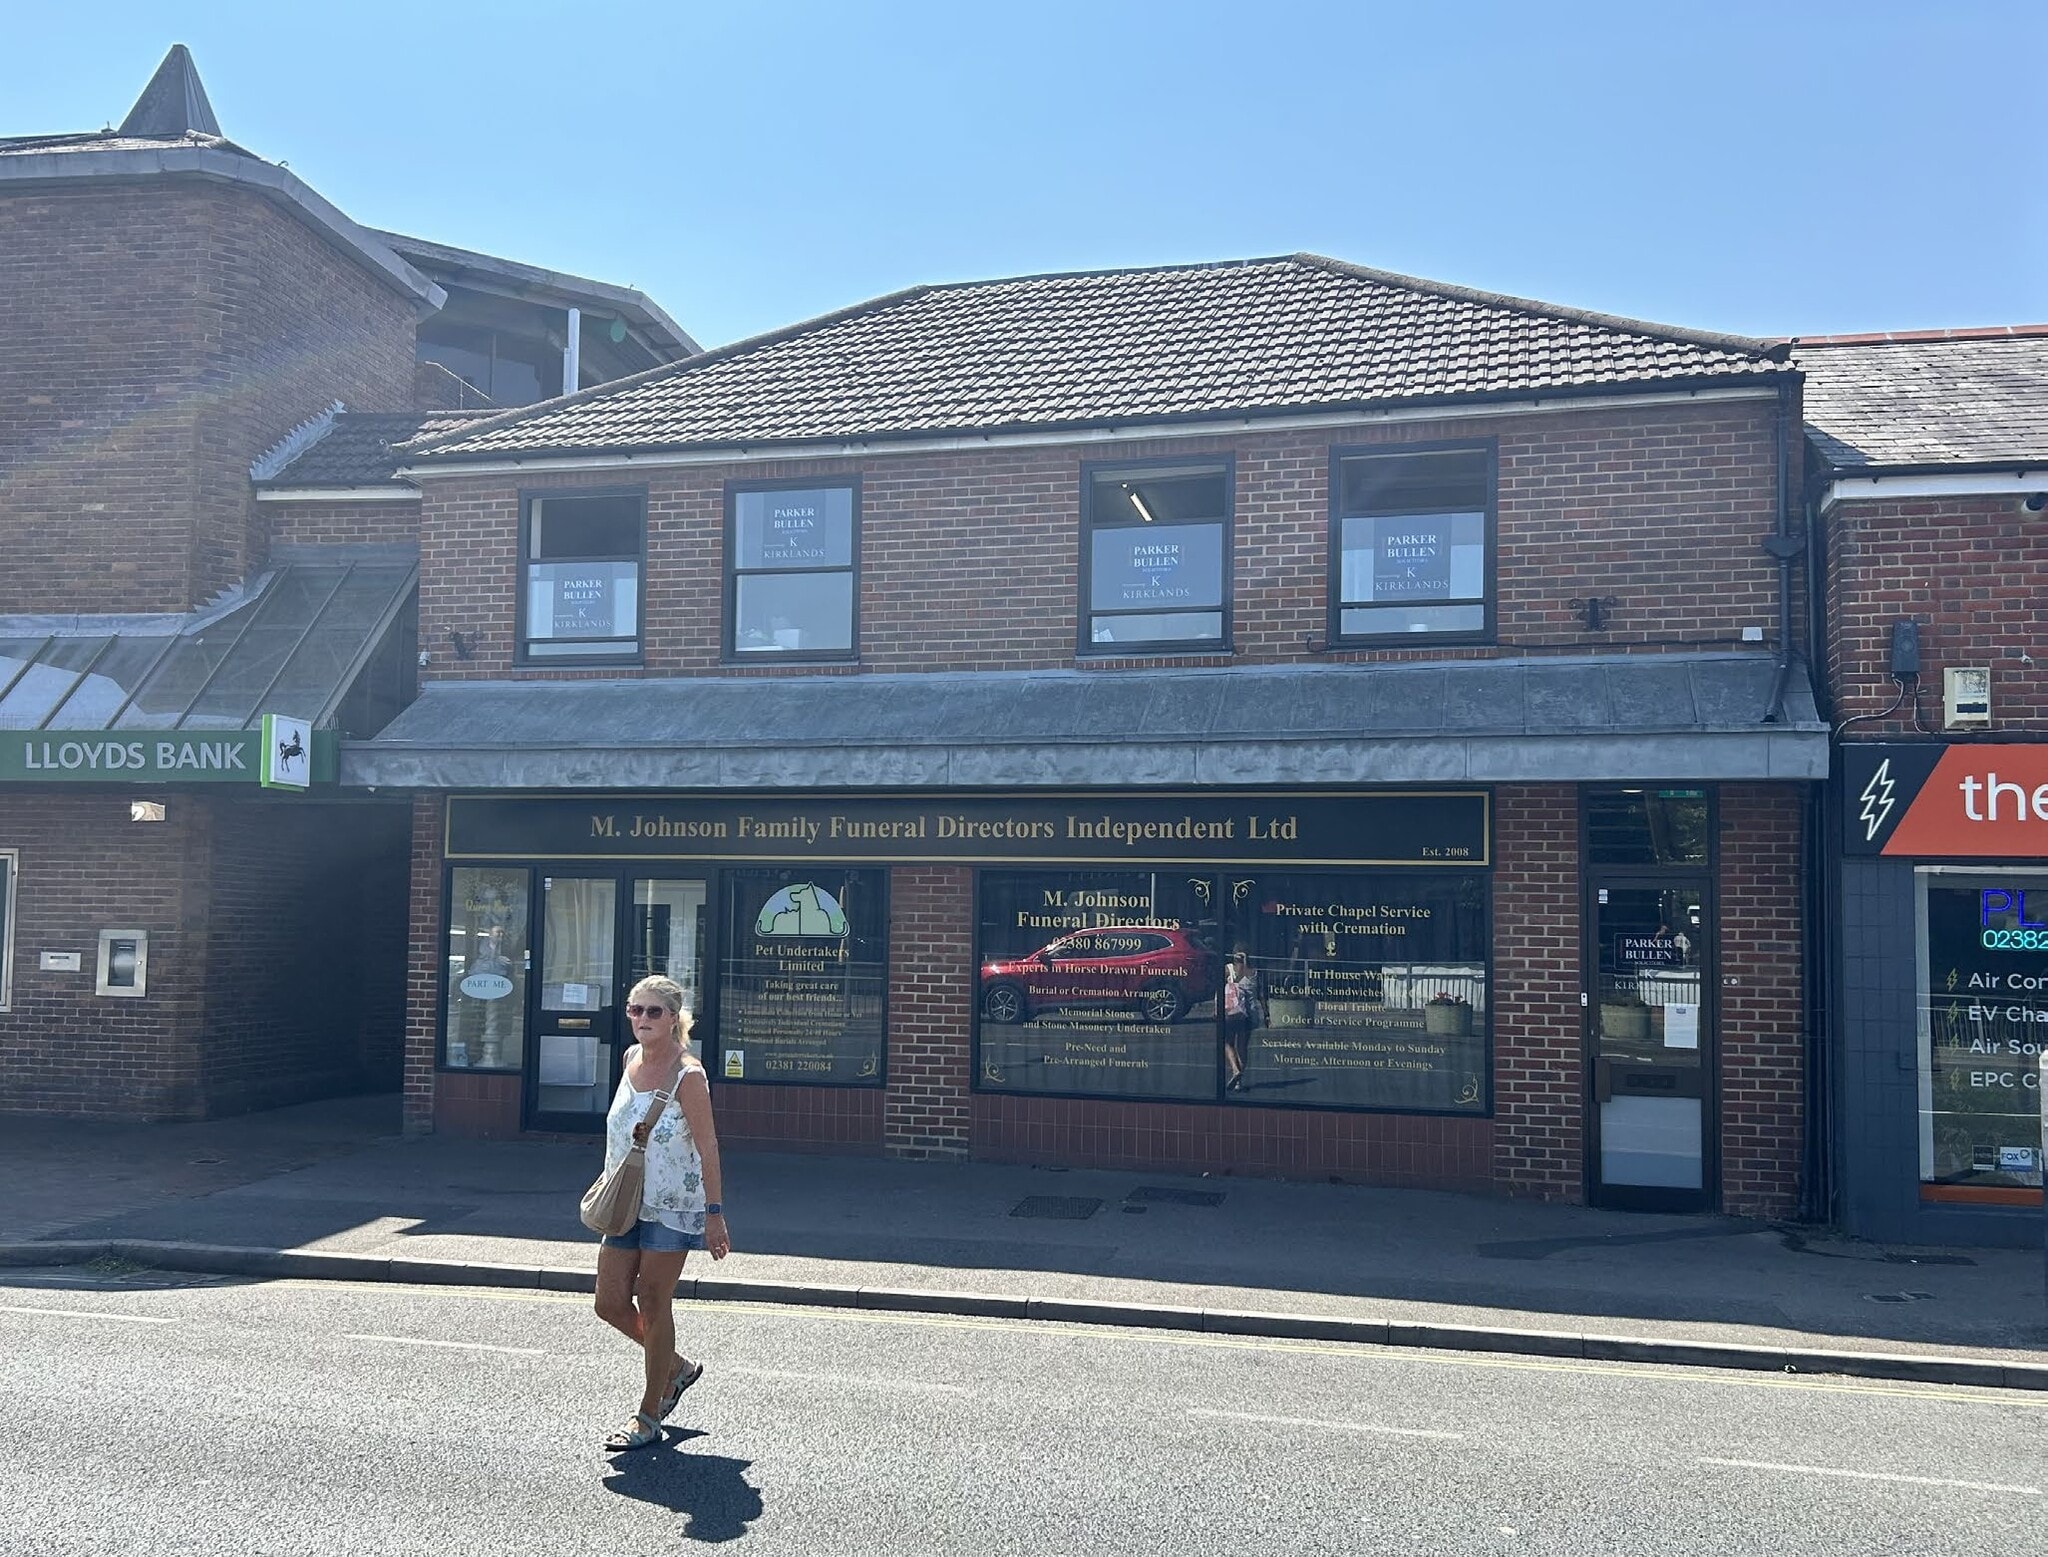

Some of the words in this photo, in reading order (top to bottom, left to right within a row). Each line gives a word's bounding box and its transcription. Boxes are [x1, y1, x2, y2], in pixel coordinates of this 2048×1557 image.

[774, 508, 815, 518] PARKER
[774, 519, 814, 528] BULLEN
[790, 537, 798, 547] K
[1388, 534, 1436, 545] PARKER
[764, 549, 825, 558] KIRKLANDS
[1134, 545, 1179, 555] PARKER
[1387, 547, 1435, 558] BULLEN
[1134, 556, 1178, 567] BULLEN
[1407, 567, 1416, 578] K
[564, 580, 602, 588] PARKER
[1151, 575, 1161, 586] K
[1375, 580, 1449, 591] KIRKLANDS
[564, 591, 601, 599] BULLEN
[1123, 588, 1190, 599] KIRKLANDS
[578, 608, 586, 617] K
[554, 620, 612, 629] KIRKLANDS
[25, 742, 146, 769] LLOYDS
[156, 742, 246, 769] BANK
[590, 815, 621, 837] M.
[629, 815, 727, 838] Johnson
[737, 816, 821, 844] Family
[829, 816, 926, 838] Funeral
[936, 815, 1055, 838] Directors
[1066, 816, 1235, 845] Independent
[1248, 816, 1297, 840] Ltd
[1422, 847, 1442, 857] Est.
[1445, 847, 1469, 857] 2008
[1043, 890, 1068, 908] M.
[1074, 891, 1151, 908] Johnson
[1276, 903, 1324, 917] Private
[1328, 904, 1376, 920] Chapel
[1380, 906, 1431, 918] Service
[1016, 911, 1087, 928] Funeral
[1095, 912, 1180, 930] Directors
[1299, 922, 1328, 934] with
[1332, 922, 1406, 936] Cremation
[1094, 938, 1142, 950] 867999
[1625, 938, 1673, 948] PARKER
[1983, 930, 2048, 948] 02382
[755, 944, 773, 956] Pet
[777, 945, 850, 957] Undertakers
[1326, 941, 1337, 956] £
[1625, 950, 1672, 960] BULLEN
[780, 960, 825, 972] Limited
[1007, 962, 1049, 975] Experts
[1051, 963, 1062, 974] in
[1065, 964, 1098, 975] Horse
[1100, 965, 1137, 976] Drawn
[1140, 965, 1188, 977] Funerals
[1308, 969, 1321, 979] In
[1324, 969, 1361, 980] House
[1968, 972, 2000, 988] Air
[467, 980, 488, 988] PART
[765, 980, 794, 990] Taking
[795, 981, 818, 991] great
[820, 982, 839, 990] care
[758, 992, 768, 1000] of
[1029, 985, 1057, 995] Burial
[1071, 986, 1120, 997] Cremation
[1121, 988, 1167, 1000] Arranged
[1269, 985, 1288, 996] Tea,
[1291, 985, 1324, 996] Coffee,
[1326, 987, 1384, 998] Sandwiches
[1318, 1002, 1348, 1012] Floral
[1059, 1007, 1103, 1018] Memorial
[1104, 1009, 1135, 1019] Stones
[1968, 1006, 1998, 1021] EV
[1281, 1014, 1312, 1024] Order
[1314, 1015, 1326, 1025] of
[1326, 1016, 1363, 1026] Service
[1365, 1017, 1425, 1028] Programme
[1023, 1020, 1040, 1030] and
[1042, 1021, 1067, 1030] Stone
[1117, 1024, 1171, 1034] Undertaken
[1065, 1042, 1107, 1053] Pre-Need
[1109, 1044, 1127, 1053] and
[1261, 1038, 1301, 1049] Services
[1304, 1040, 1349, 1051] Available
[1351, 1042, 1392, 1053] Monday
[1395, 1043, 1405, 1052] to
[1407, 1044, 1446, 1056] Sunday
[1969, 1038, 2001, 1054] Air
[766, 1060, 794, 1071] 02381
[797, 1060, 832, 1072] 220084
[1044, 1055, 1106, 1068] Pre-Arranged
[1108, 1058, 1149, 1069] Funerals
[1273, 1054, 1320, 1066] Morning,
[1322, 1056, 1371, 1067] Afternoon
[1373, 1059, 1385, 1067] or
[1387, 1058, 1434, 1070] Evenings
[1970, 1071, 2015, 1088] EPC
[2022, 1073, 2040, 1088] C
[2001, 1152, 2019, 1161] FOX
